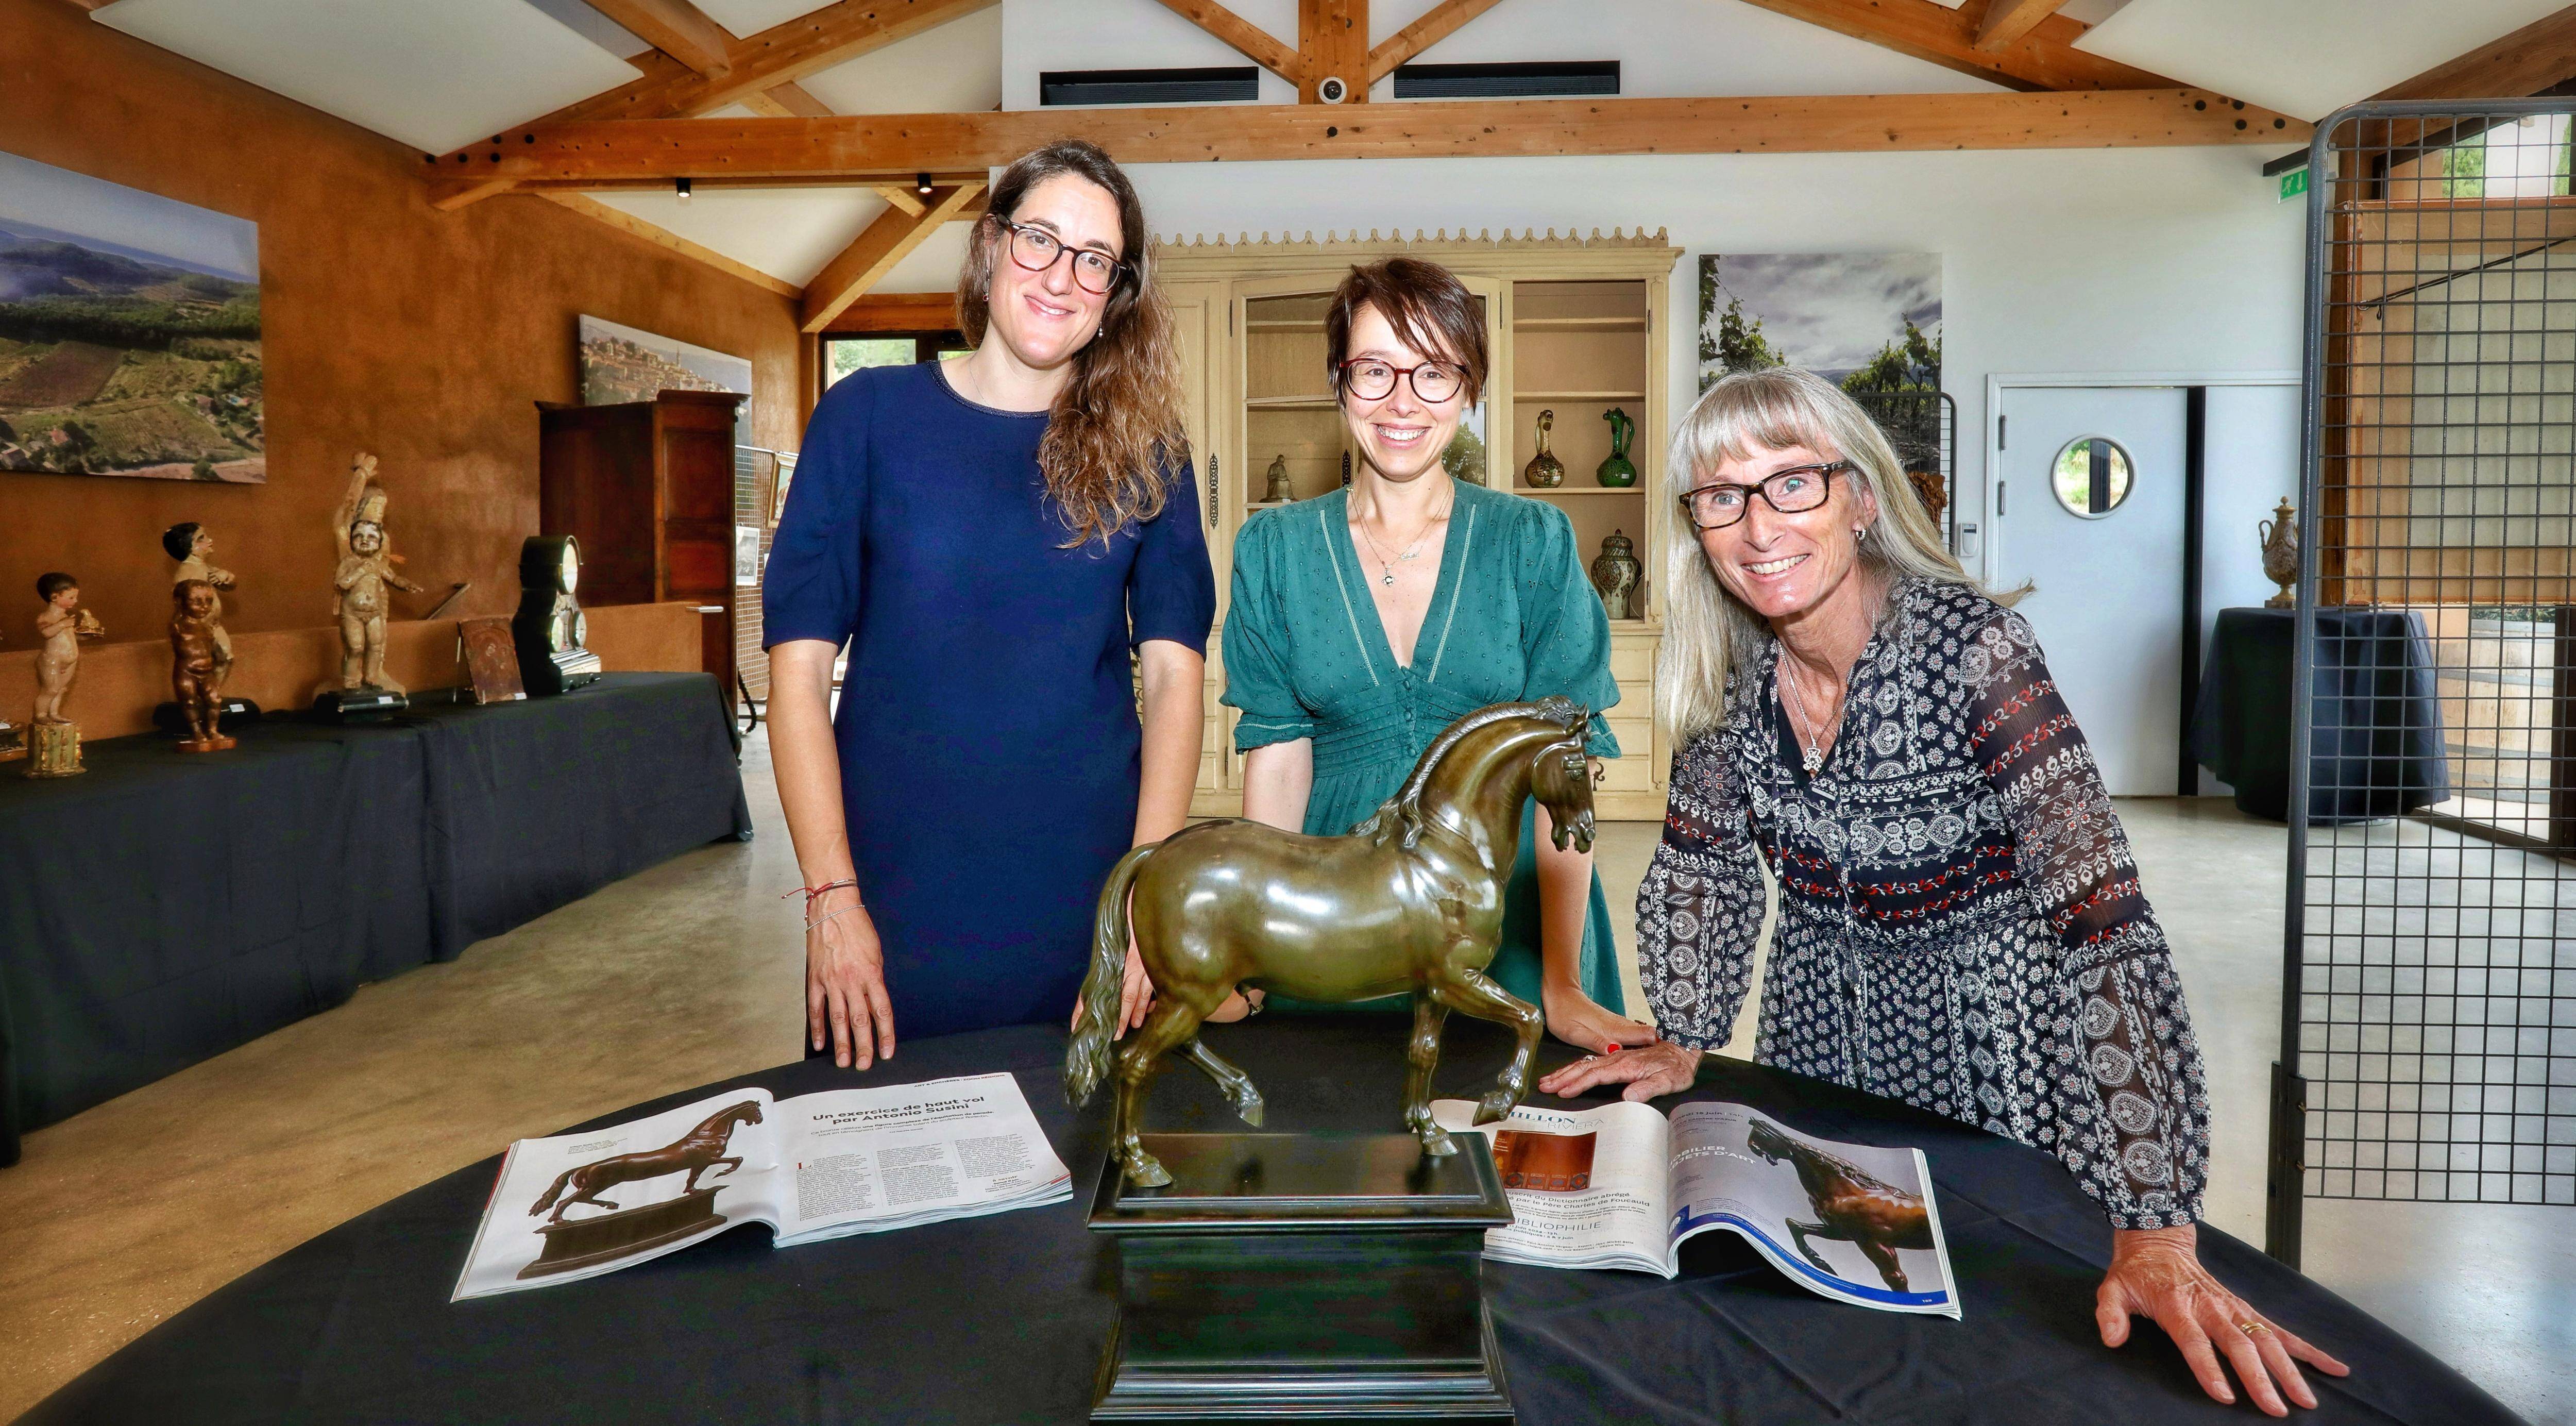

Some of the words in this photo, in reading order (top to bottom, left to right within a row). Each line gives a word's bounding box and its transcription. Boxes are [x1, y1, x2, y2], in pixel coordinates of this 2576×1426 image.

[838, 1109, 899, 1117] exercice
[925, 1099, 959, 1108] haut
[862, 1111, 922, 1121] Antonio
[925, 1103, 969, 1113] Susini
[1511, 1112, 1577, 1124] ILLON
[1547, 1119, 1604, 1130] RIVIERA
[1714, 1151, 1756, 1164] D'ART
[1611, 1198, 1650, 1206] Foucauld
[1517, 1218, 1602, 1231] IBLIOPHILIE
